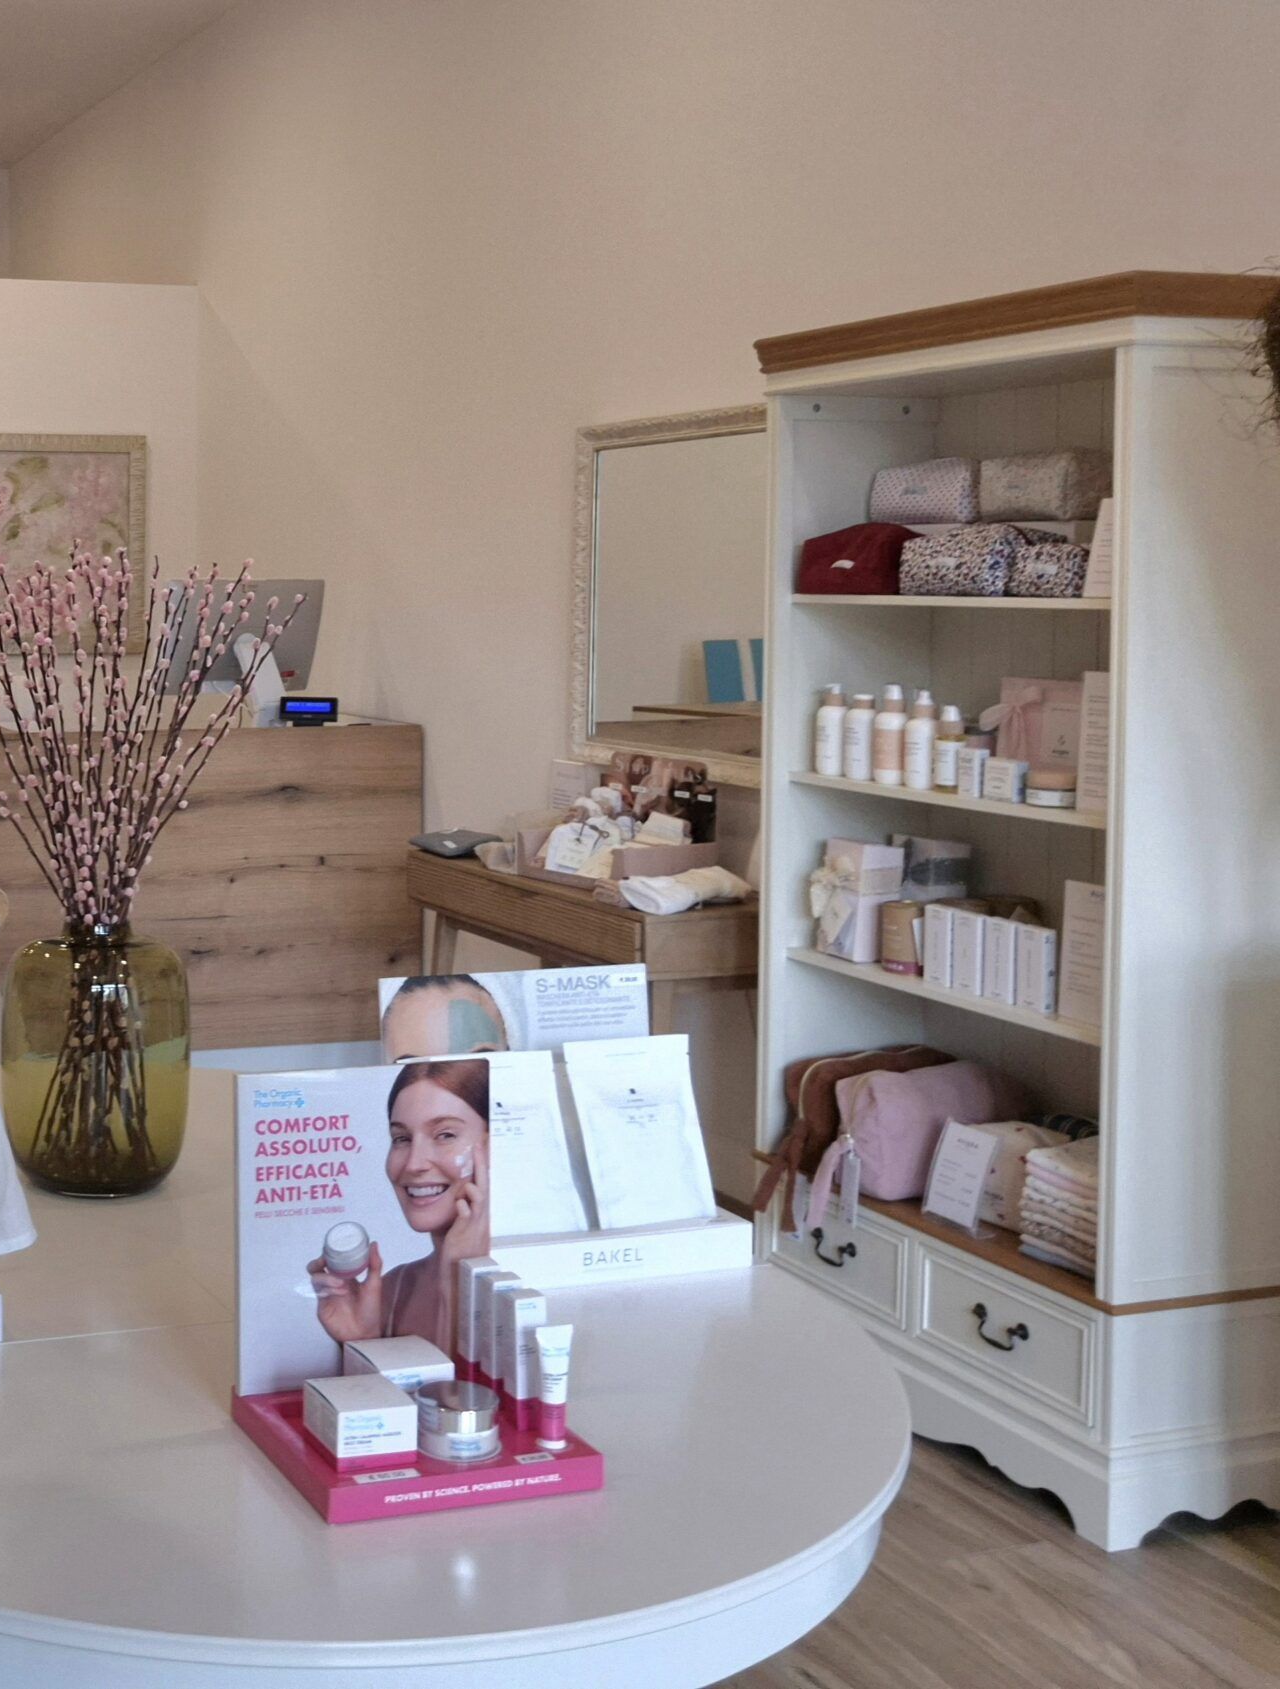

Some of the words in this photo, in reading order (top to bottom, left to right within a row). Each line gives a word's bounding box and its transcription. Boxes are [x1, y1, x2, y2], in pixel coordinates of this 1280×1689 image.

[536, 975, 611, 993] S-MASK
[254, 1114, 350, 1136] COMFORT
[254, 1136, 362, 1157] ASSOLUTO,
[255, 1161, 350, 1182] EFFICACIA
[254, 1179, 344, 1204] ANTI-ETÀ
[582, 1248, 644, 1266] BAKEL
[384, 1492, 421, 1504] PROVEN
[422, 1490, 434, 1499] BY
[472, 1479, 514, 1492] POWERED
[515, 1478, 526, 1487] BY
